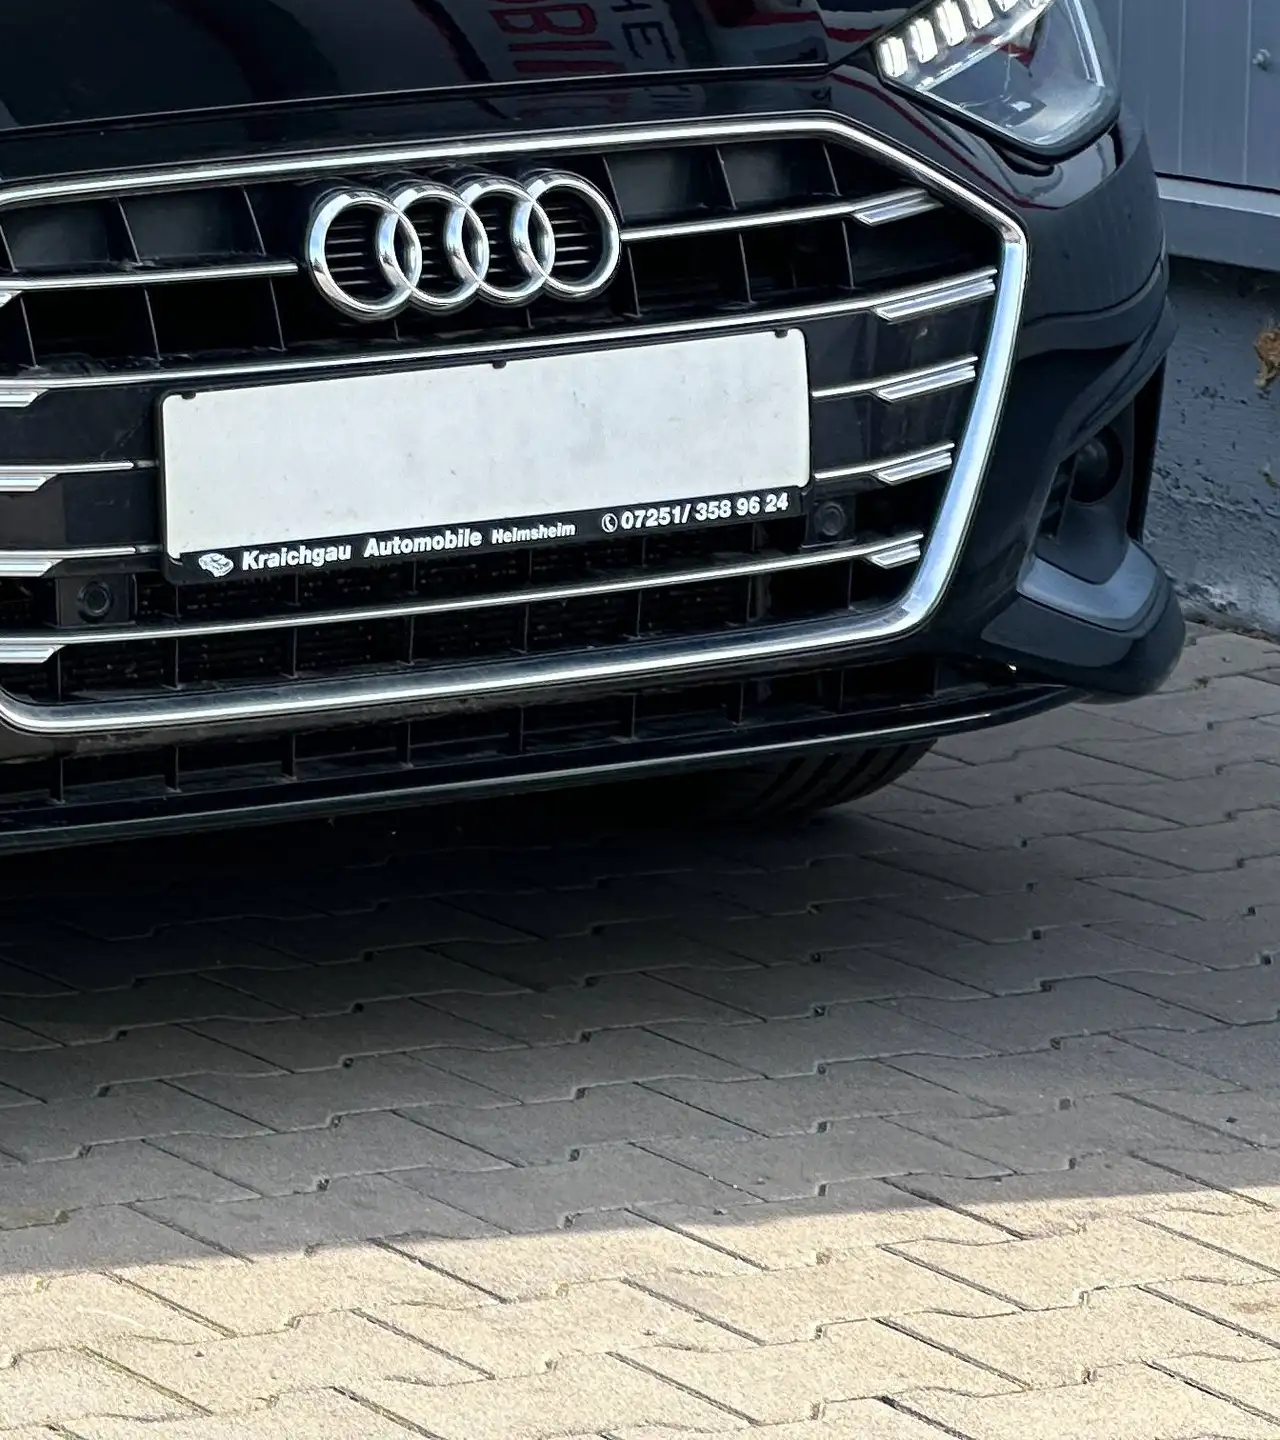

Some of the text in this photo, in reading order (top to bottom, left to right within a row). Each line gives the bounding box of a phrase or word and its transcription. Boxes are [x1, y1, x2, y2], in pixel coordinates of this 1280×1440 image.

[242, 492, 789, 571] Kraichgau Automobile Helmsheim 07251/ 358 96 24
